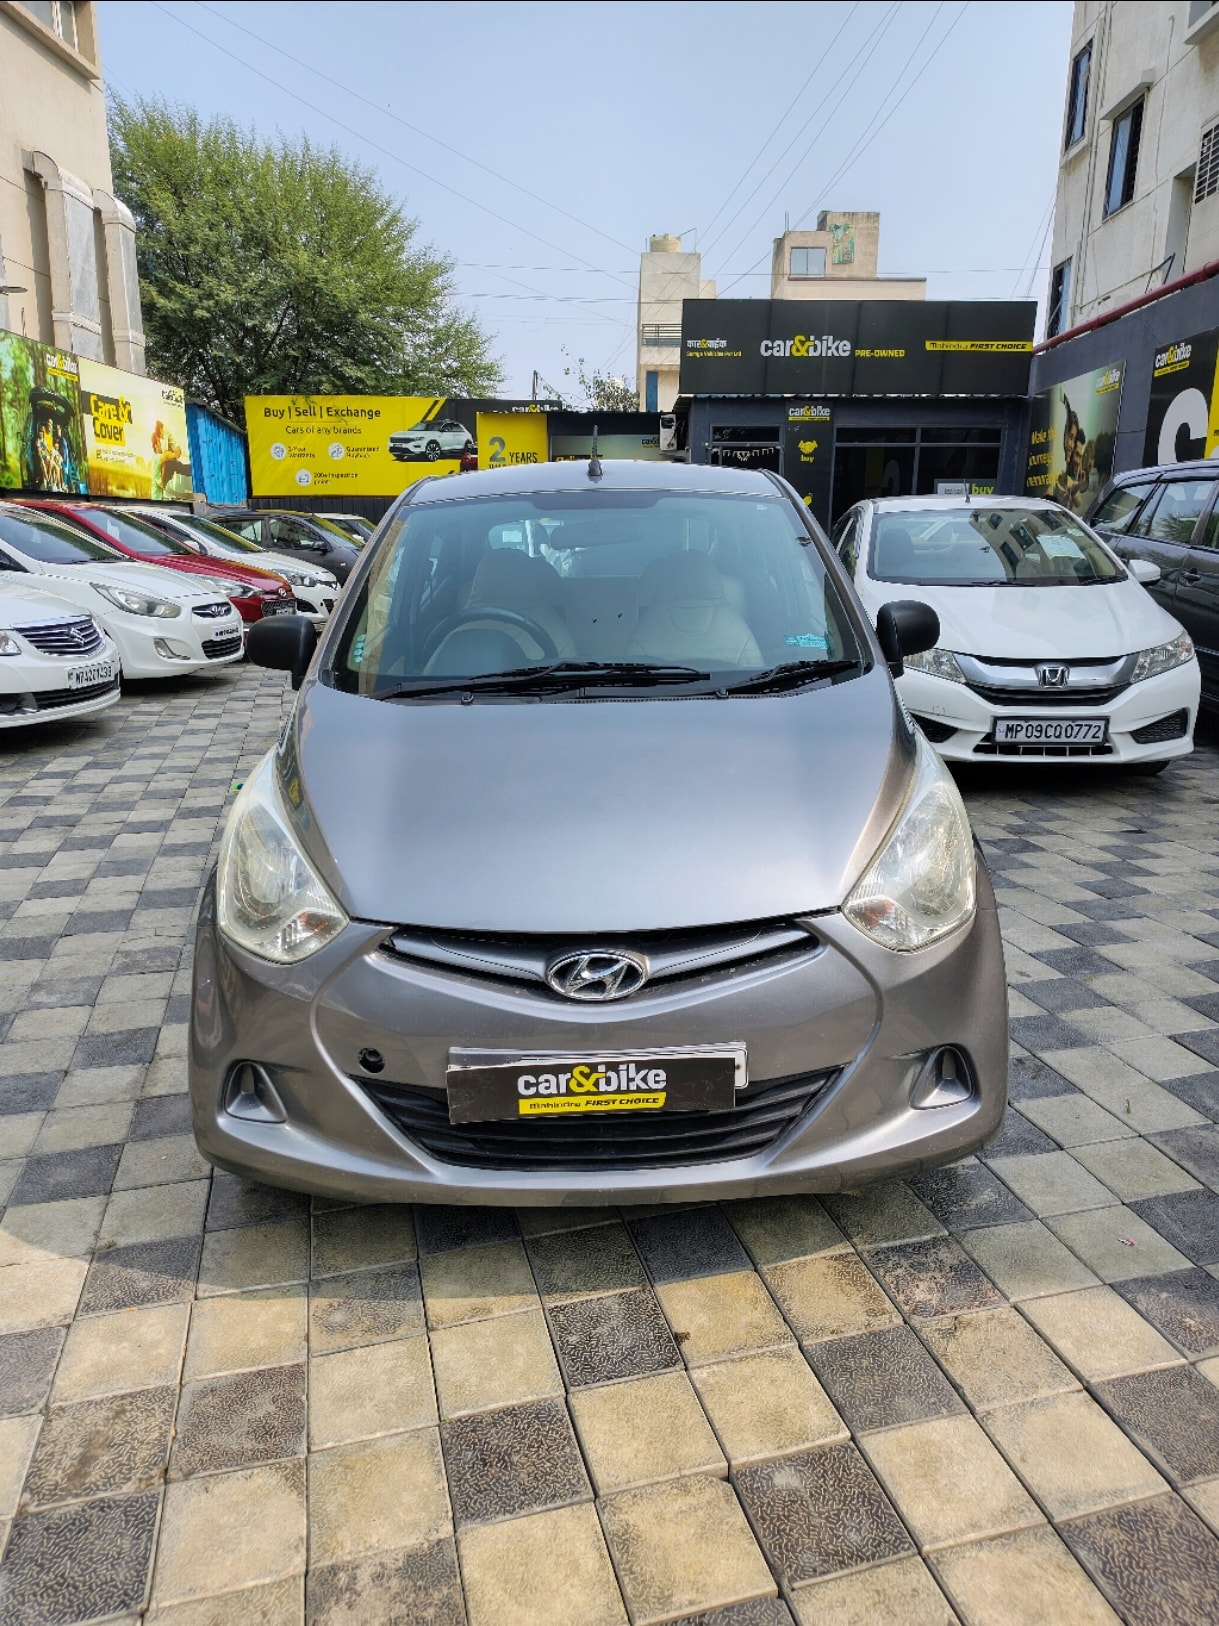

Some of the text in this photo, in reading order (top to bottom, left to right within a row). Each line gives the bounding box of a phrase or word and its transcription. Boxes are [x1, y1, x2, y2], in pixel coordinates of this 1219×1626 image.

[760, 335, 906, 358] car&bike PRE-OWNED
[1155, 342, 1193, 369] car&bike
[90, 394, 118, 420] Care
[263, 407, 285, 418] Buy
[295, 406, 316, 417] Sell
[326, 406, 381, 419] Exchange
[788, 405, 831, 416] car&bike
[93, 416, 124, 443] Cover
[285, 425, 362, 436] Cars of any brands
[488, 436, 538, 464] 2 YEARS
[800, 454, 815, 463] buy
[971, 484, 995, 496] buy
[1005, 723, 1102, 739] MP09CQ0772
[517, 1063, 667, 1095] car&bike
[584, 1098, 618, 1107] FIRST
[619, 1097, 660, 1105] CHOICE
